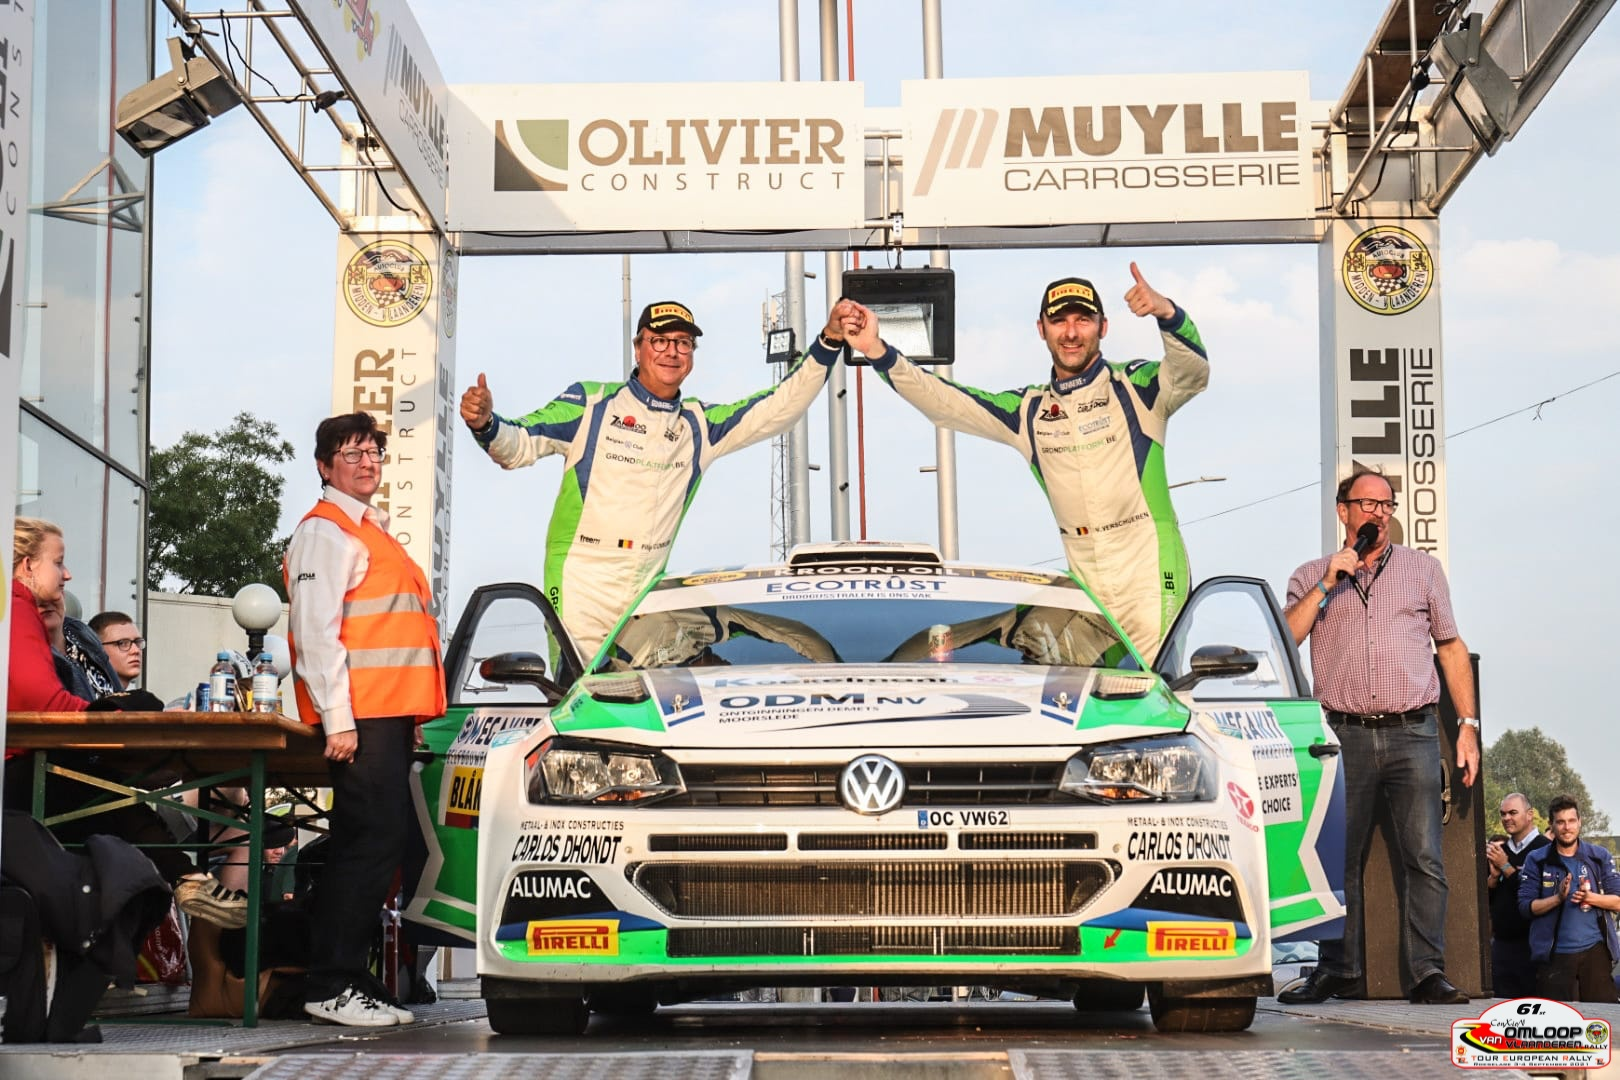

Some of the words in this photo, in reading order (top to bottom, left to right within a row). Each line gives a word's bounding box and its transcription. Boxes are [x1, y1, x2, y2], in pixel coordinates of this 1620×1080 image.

[400, 43, 445, 161] MUYLLE
[1003, 101, 1299, 158] MUYLLE
[578, 118, 846, 167] OLIVIER
[581, 171, 846, 191] CONSTRUCT
[1004, 162, 1300, 192] CARROSSERIE
[351, 287, 374, 314] MIDDEN
[1351, 274, 1375, 303] MIDDEN
[396, 348, 416, 546] ONSTRUCT
[1410, 348, 1437, 555] ROSSERIE
[774, 565, 960, 576] KROON-OIL
[719, 693, 865, 708] ODM
[877, 697, 927, 705] NV
[719, 713, 799, 723] MOORSLEDE
[1262, 797, 1291, 814] CHOICE
[550, 820, 565, 829] INOX
[568, 820, 624, 831] CONSTRUCTIES
[930, 811, 954, 826] OC
[960, 811, 1009, 826] VW62
[512, 834, 561, 862] CARLOS
[560, 835, 622, 864] DHONDT
[1127, 831, 1183, 860] CARLOS
[1186, 832, 1232, 861] DHONDT
[511, 876, 592, 898] ALUMAC
[1150, 872, 1232, 897] ALUMAC
[533, 926, 609, 950] PIRELLI
[1155, 928, 1229, 951] PIRELLI
